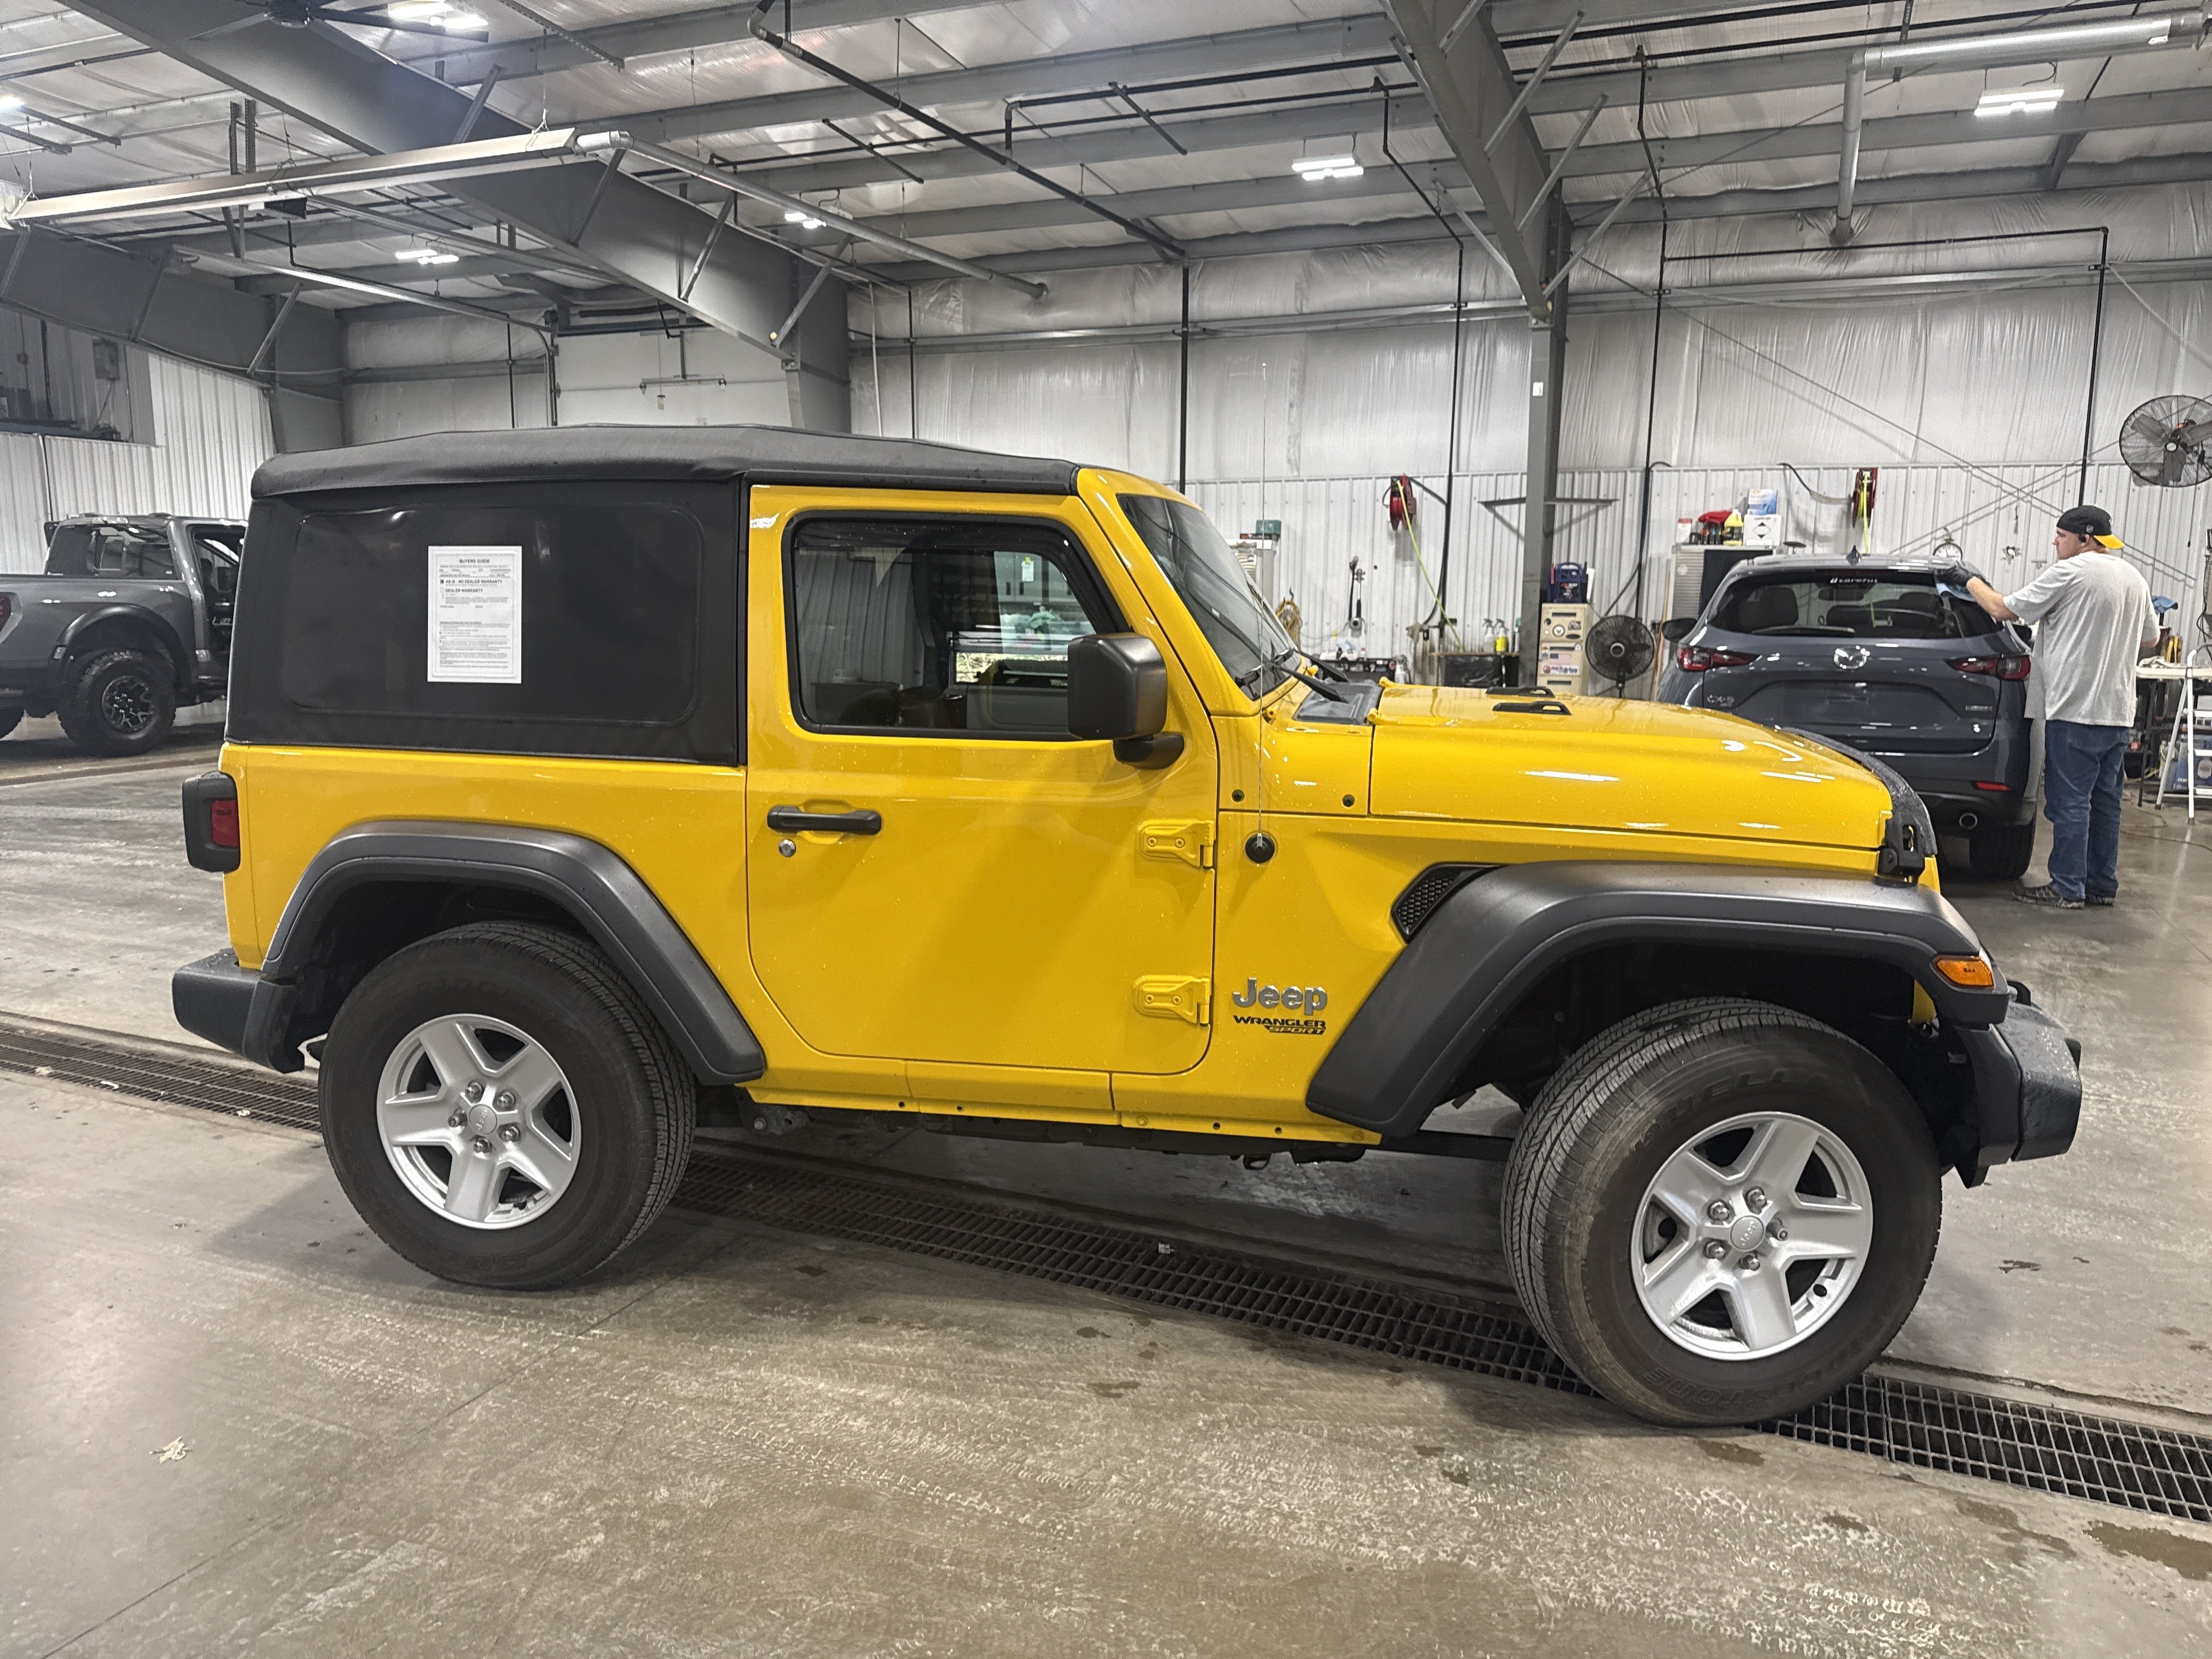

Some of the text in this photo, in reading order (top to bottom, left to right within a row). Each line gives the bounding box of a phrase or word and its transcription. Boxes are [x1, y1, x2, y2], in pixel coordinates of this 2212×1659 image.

[1232, 977, 1328, 1015] Jeep
[1233, 1015, 1326, 1028] WRANGLER
[1268, 1026, 1325, 1034] SPORT
